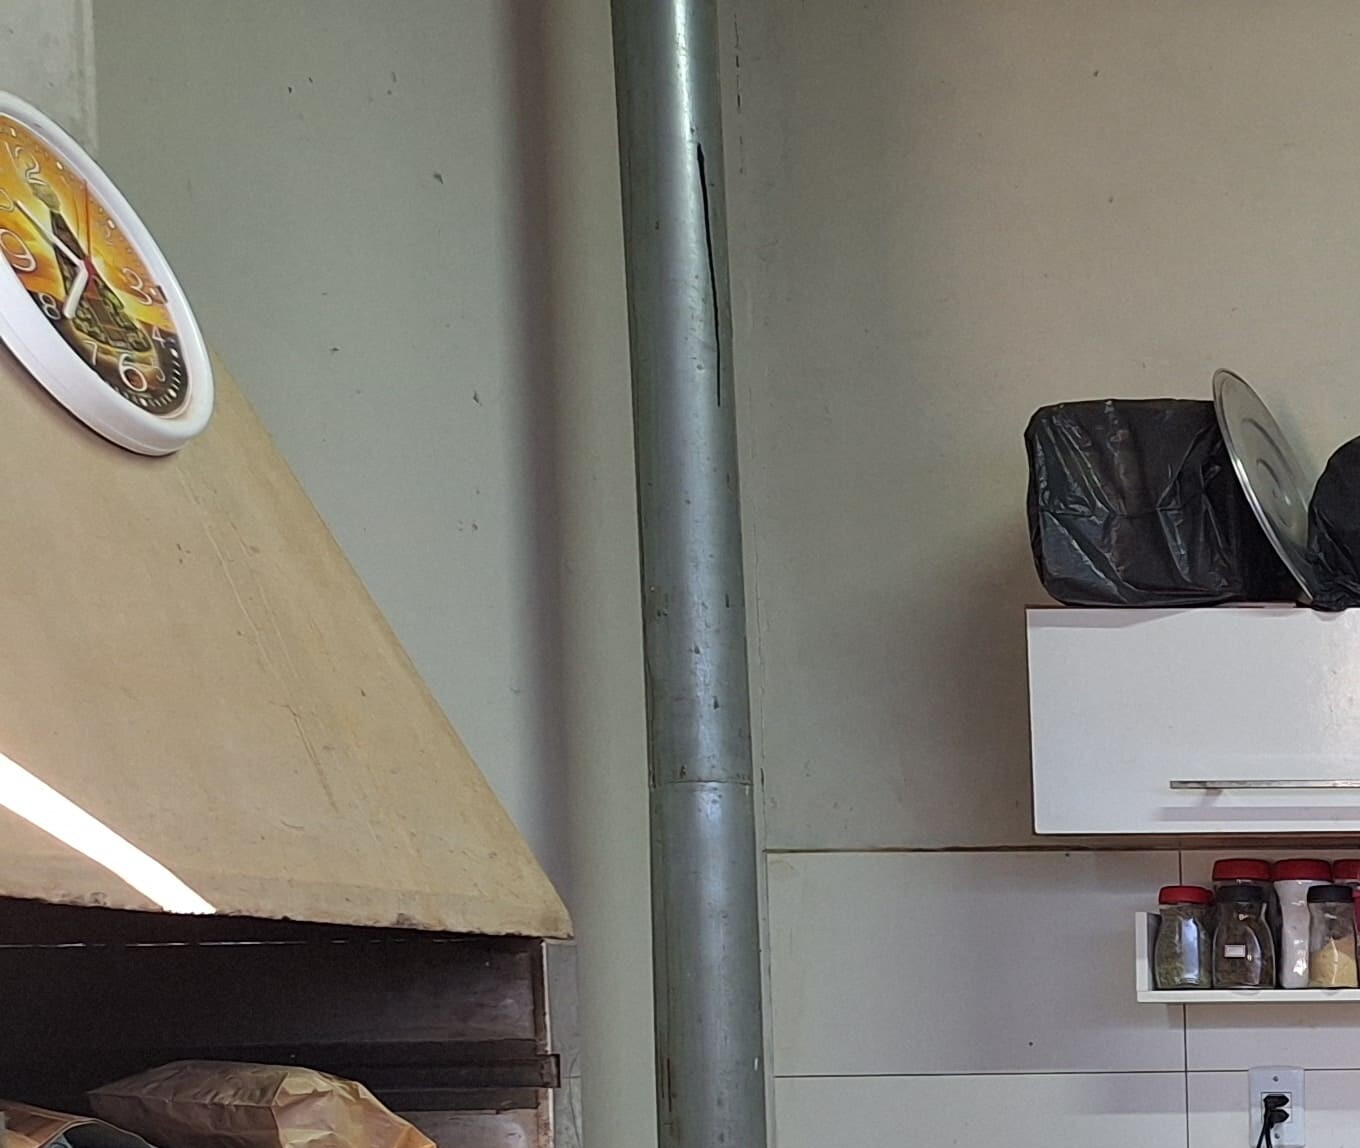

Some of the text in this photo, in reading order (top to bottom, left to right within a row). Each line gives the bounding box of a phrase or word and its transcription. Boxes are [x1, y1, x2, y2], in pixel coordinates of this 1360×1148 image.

[122, 268, 152, 305] 3
[39, 292, 61, 320] 8
[118, 353, 148, 392] 6
